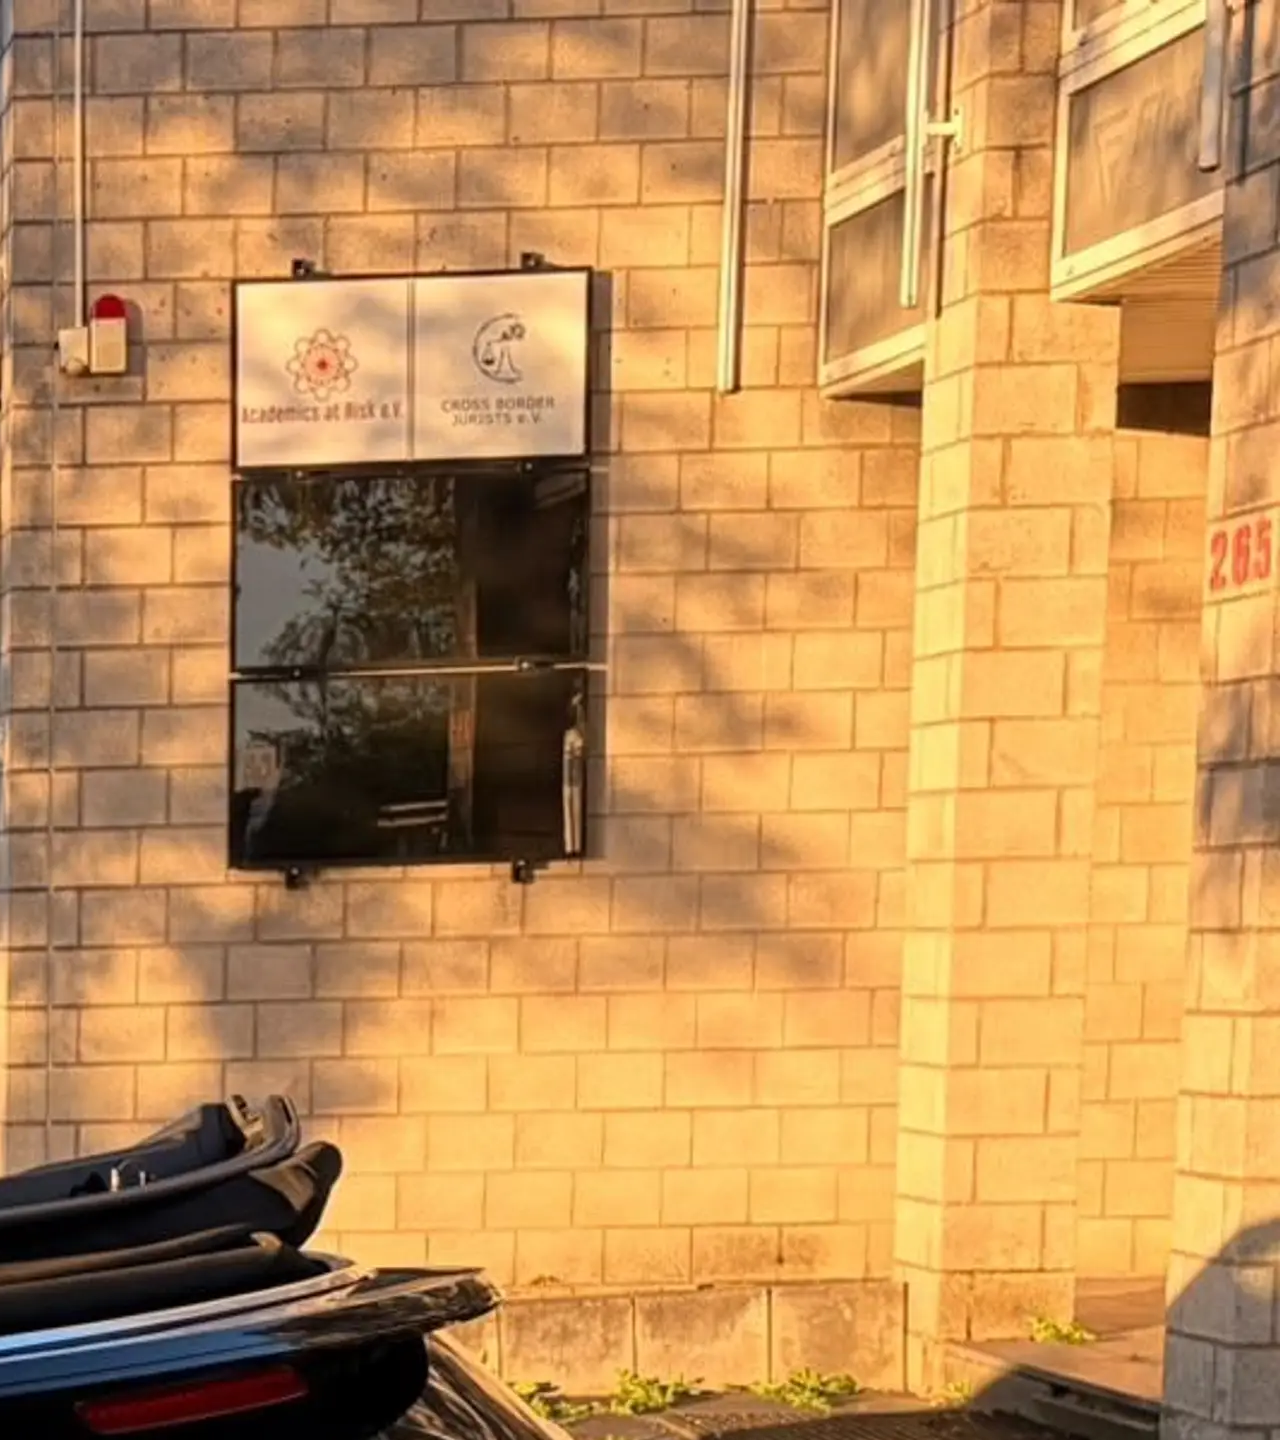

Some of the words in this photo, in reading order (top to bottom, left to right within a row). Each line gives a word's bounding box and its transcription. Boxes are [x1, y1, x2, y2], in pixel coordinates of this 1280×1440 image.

[241, 403, 319, 424] Academics
[324, 402, 340, 419] at
[344, 401, 375, 420] Risk
[441, 398, 489, 412] CROSS
[495, 396, 555, 410] BORDER
[452, 412, 512, 426] JURISTS
[1208, 518, 1272, 592] 265
